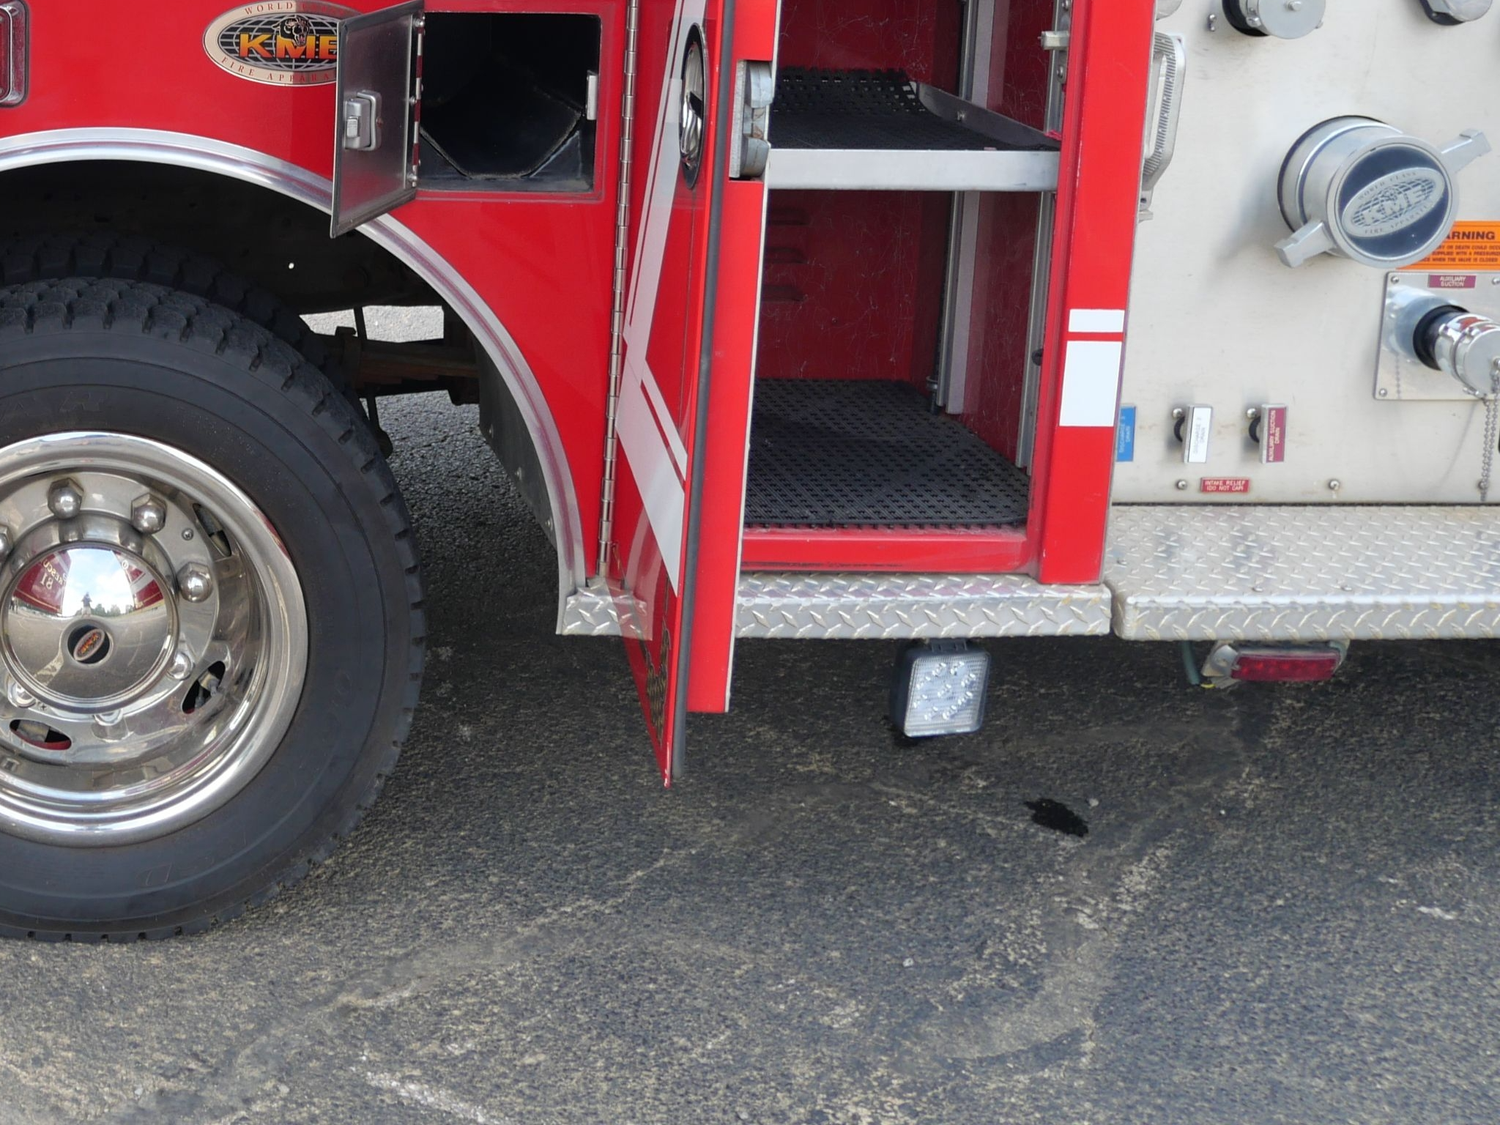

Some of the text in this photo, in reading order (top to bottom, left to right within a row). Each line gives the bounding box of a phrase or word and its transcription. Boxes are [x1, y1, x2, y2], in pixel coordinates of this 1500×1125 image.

[244, 1, 294, 15] WORLD
[239, 31, 337, 60] KME
[220, 57, 330, 82] FIRE APPARA
[1445, 231, 1496, 240] RNING
